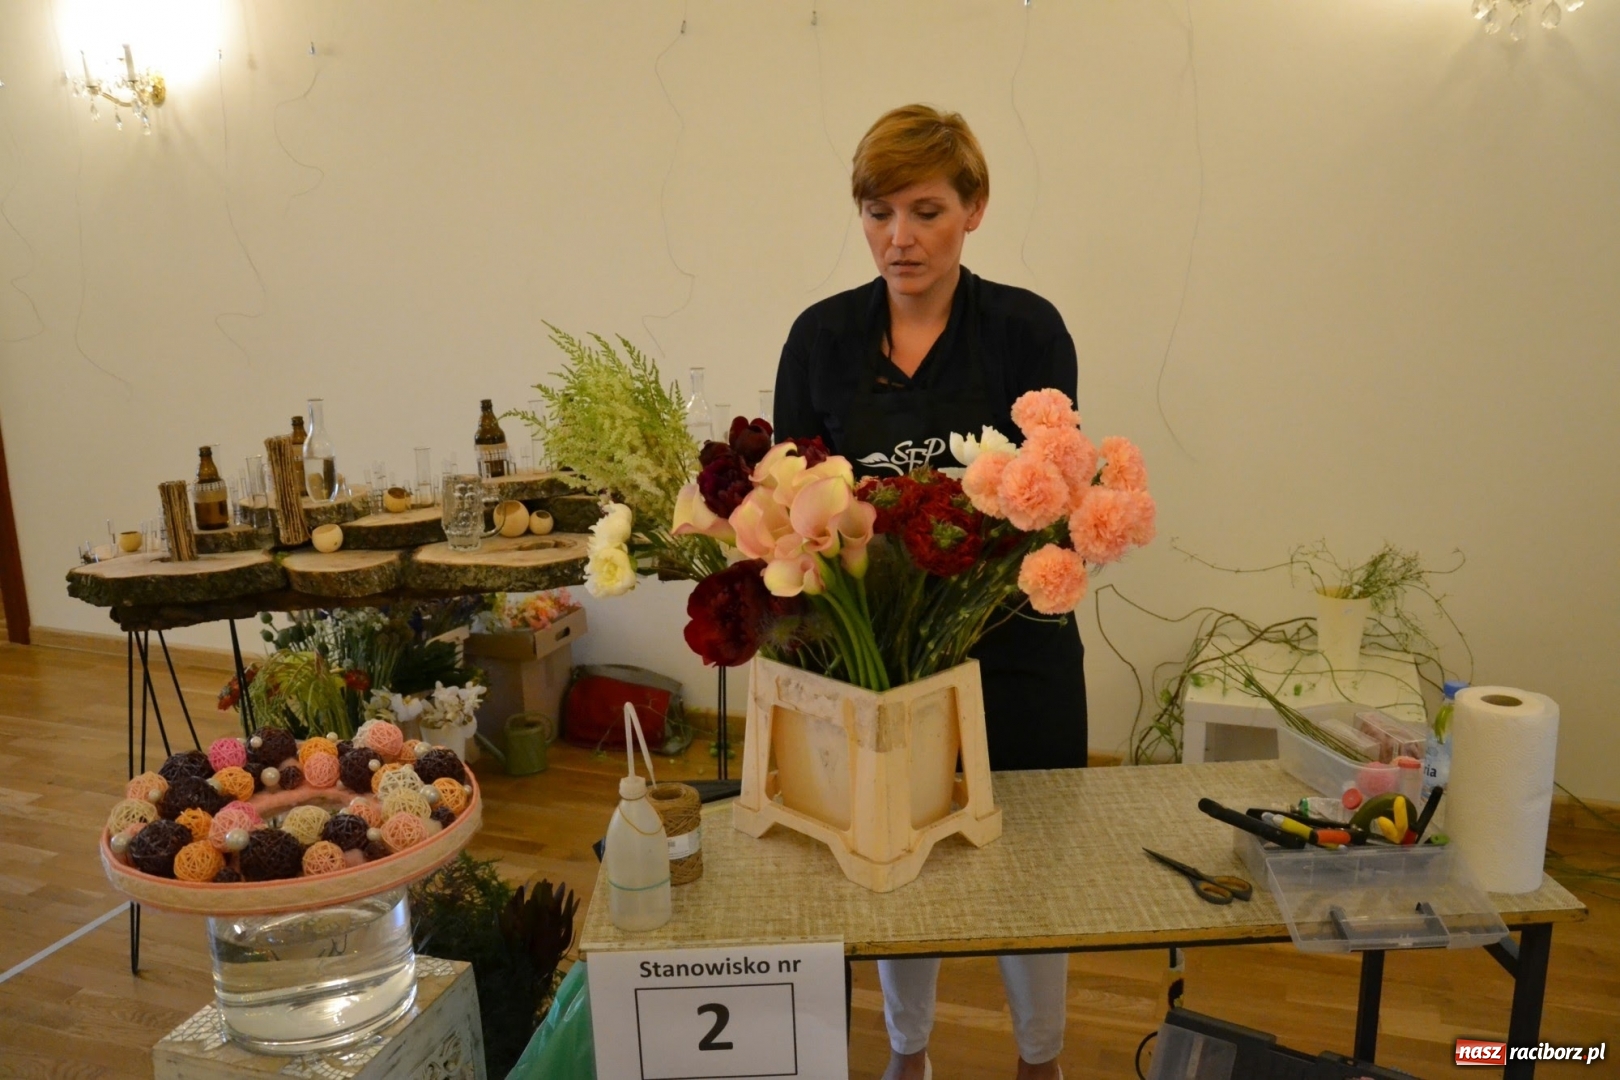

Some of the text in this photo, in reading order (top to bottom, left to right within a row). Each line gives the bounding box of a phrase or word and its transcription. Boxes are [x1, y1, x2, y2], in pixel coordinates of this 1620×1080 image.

[640, 957, 801, 978] Stanowisko nr
[697, 1003, 733, 1051] 2
